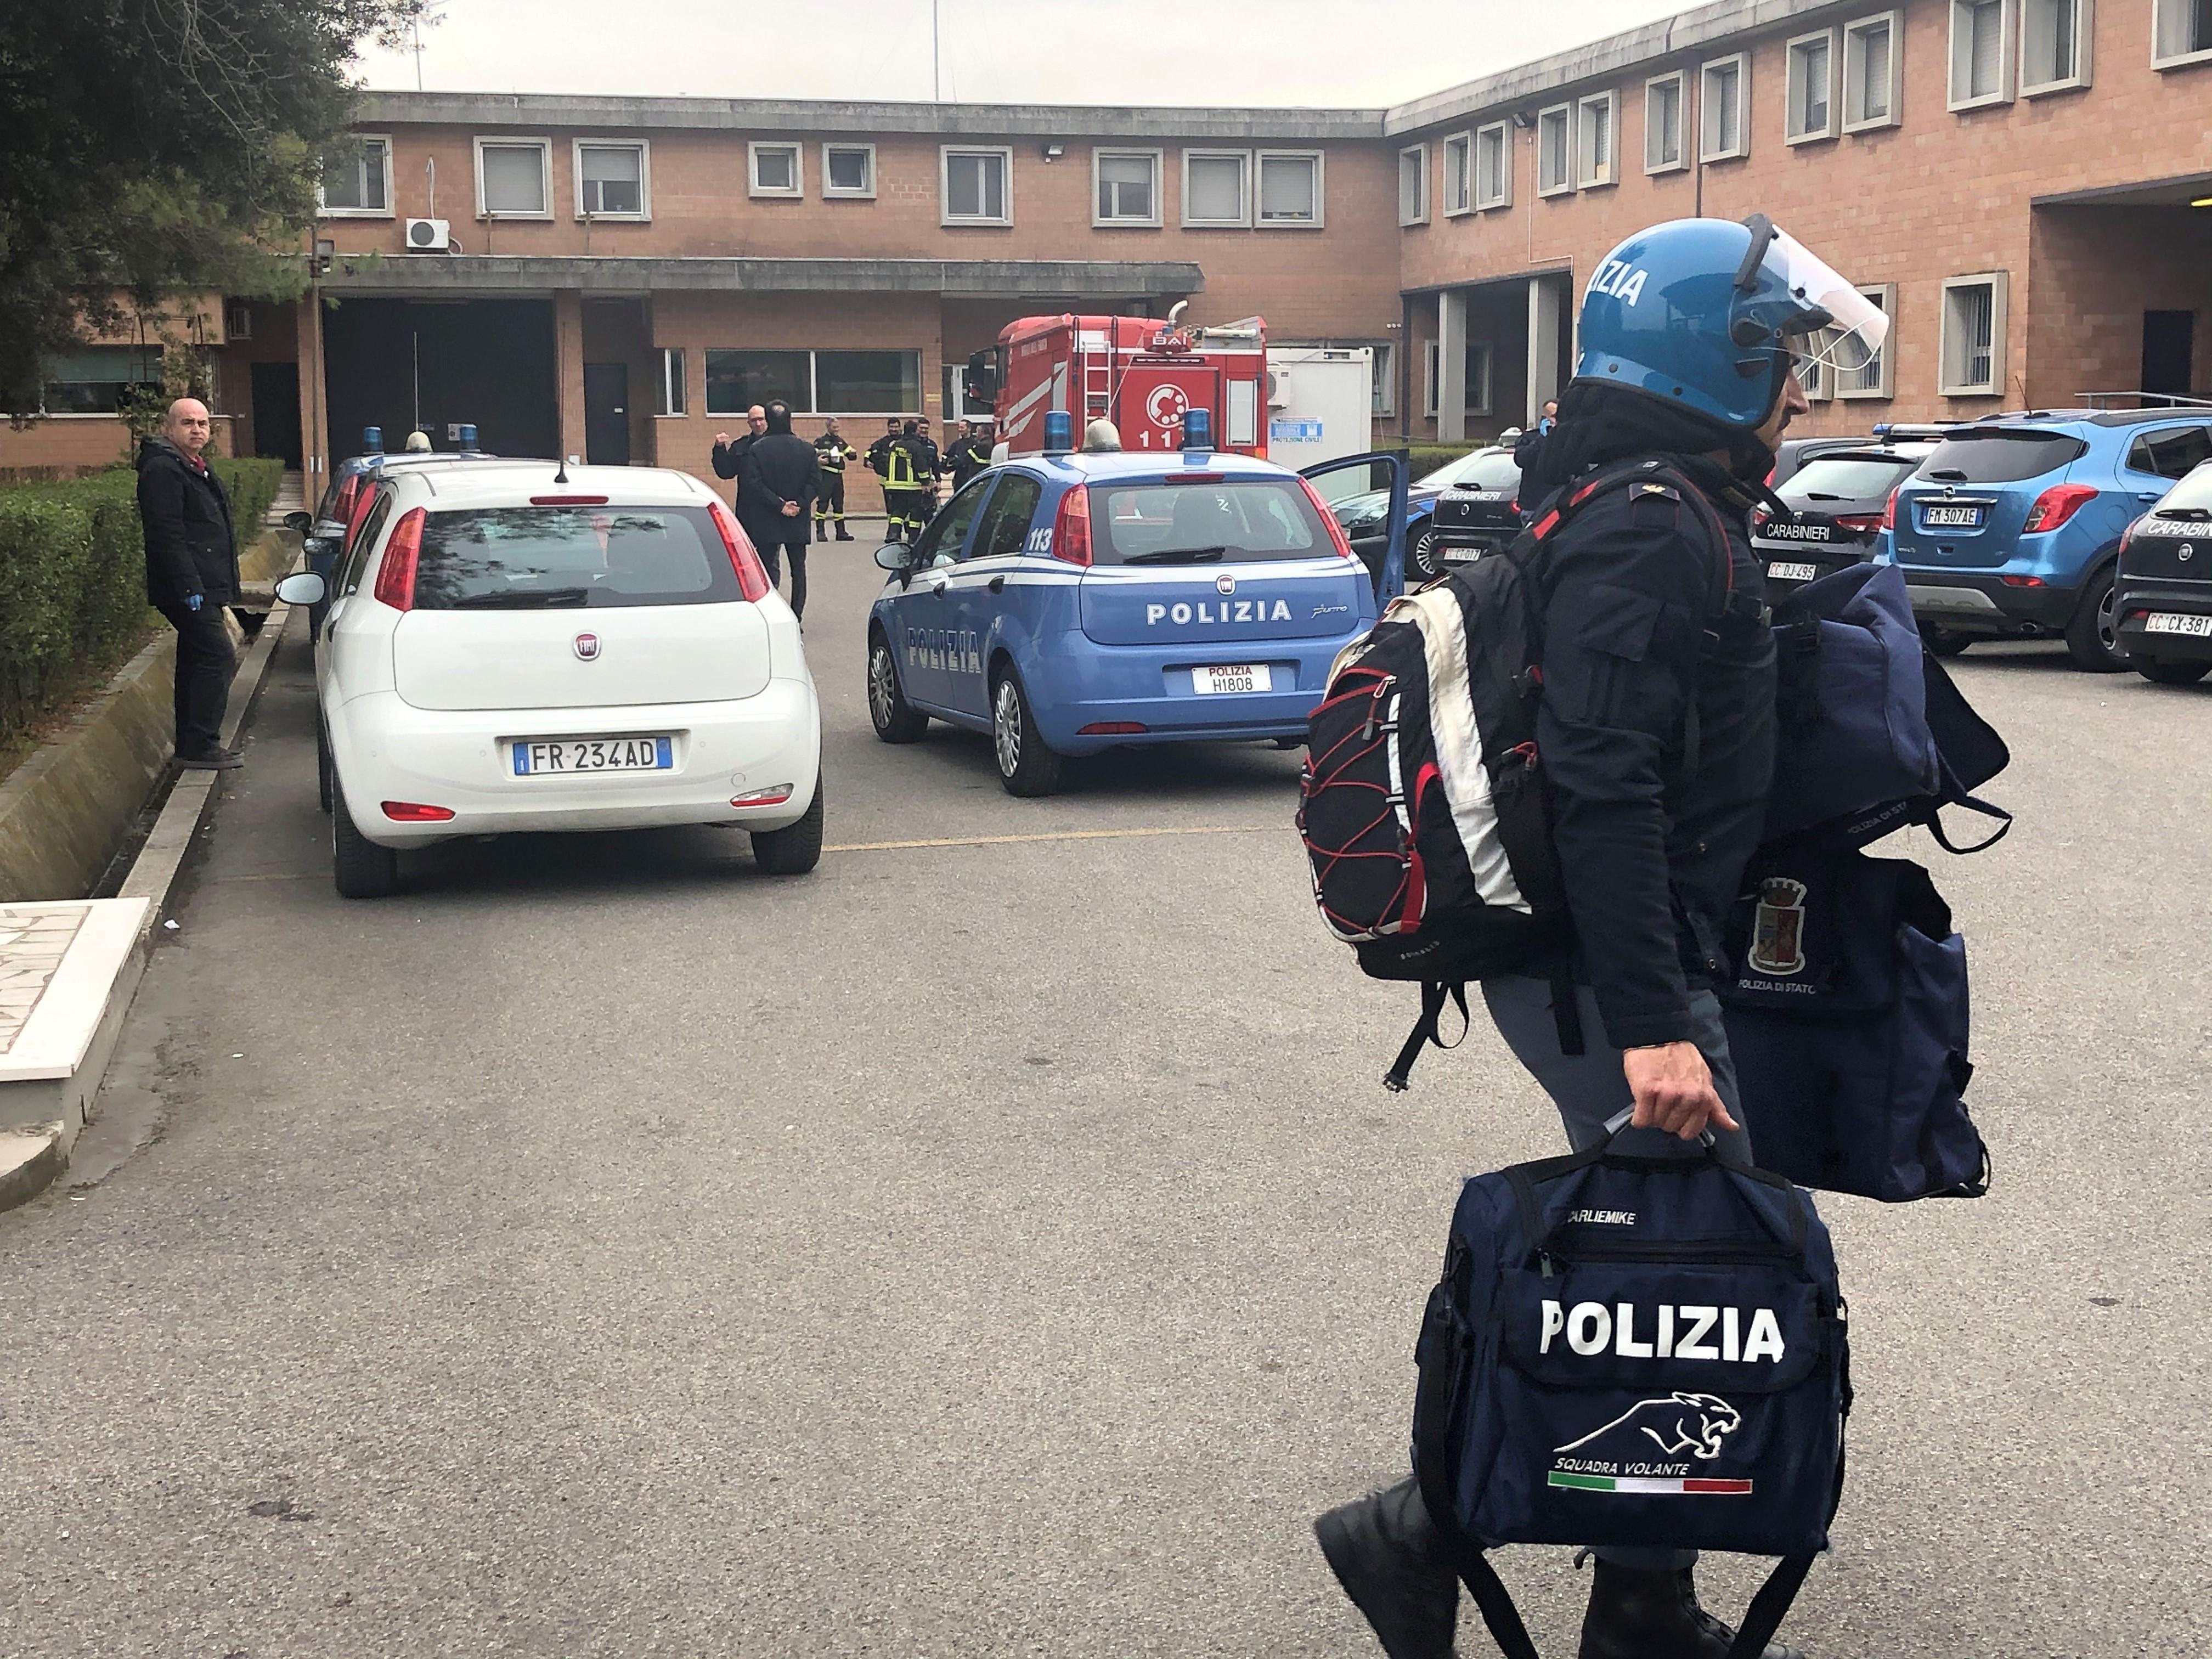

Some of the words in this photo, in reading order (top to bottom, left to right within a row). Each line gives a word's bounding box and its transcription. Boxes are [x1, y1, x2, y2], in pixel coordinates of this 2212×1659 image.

[1139, 430, 1184, 448] 11
[1446, 491, 1502, 500] CARABINIERI
[1928, 509, 1940, 523] FM
[1943, 509, 1975, 523] 307AE
[1029, 527, 1053, 551] 113
[1767, 523, 1830, 540] CARABINIERI
[1146, 600, 1292, 625] POLIZIA
[579, 639, 596, 653] FIAT
[907, 627, 981, 674] POLIZIA
[1209, 666, 1252, 676] POLIZIA
[1213, 678, 1253, 692] H1808
[532, 743, 564, 770] FR
[574, 741, 654, 769] 234AD
[1847, 817, 1882, 834] OLIZIA
[1774, 982, 1784, 992] DI
[1539, 1299, 1786, 1364] POLIZIA
[1554, 1457, 1618, 1475] SQUADRA
[1624, 1462, 1690, 1477] VOLANTE
